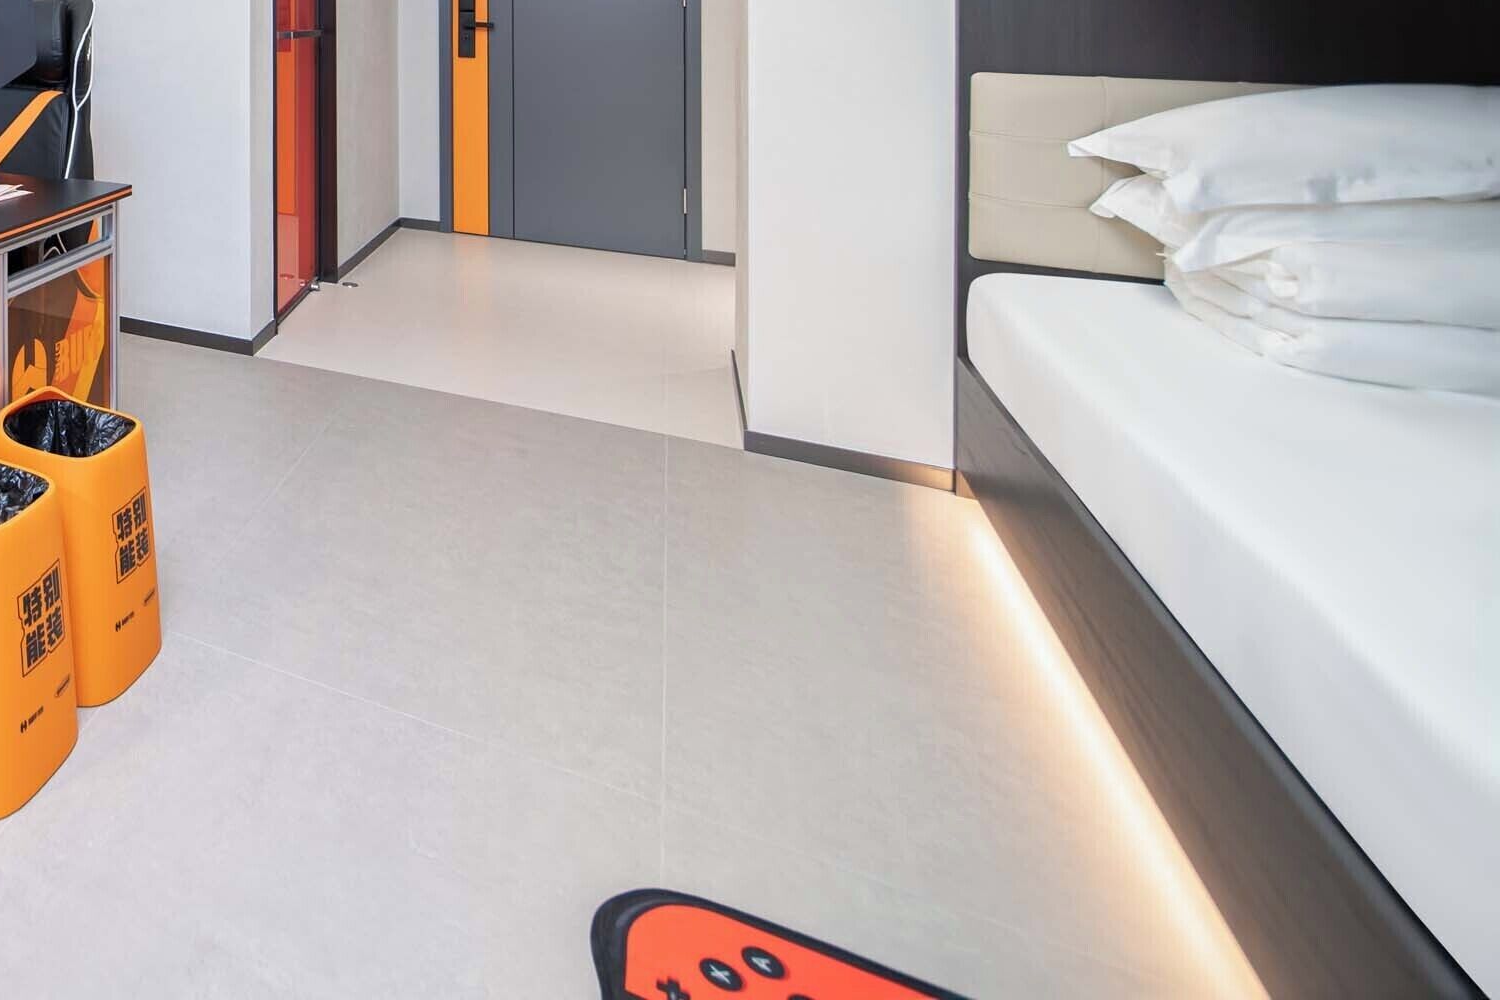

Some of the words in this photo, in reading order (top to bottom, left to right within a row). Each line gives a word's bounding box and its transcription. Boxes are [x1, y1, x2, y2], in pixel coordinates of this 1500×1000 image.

[115, 492, 147, 542] 特别
[119, 527, 149, 577] 能装
[22, 566, 60, 628] 特别
[25, 605, 64, 669] 能装
